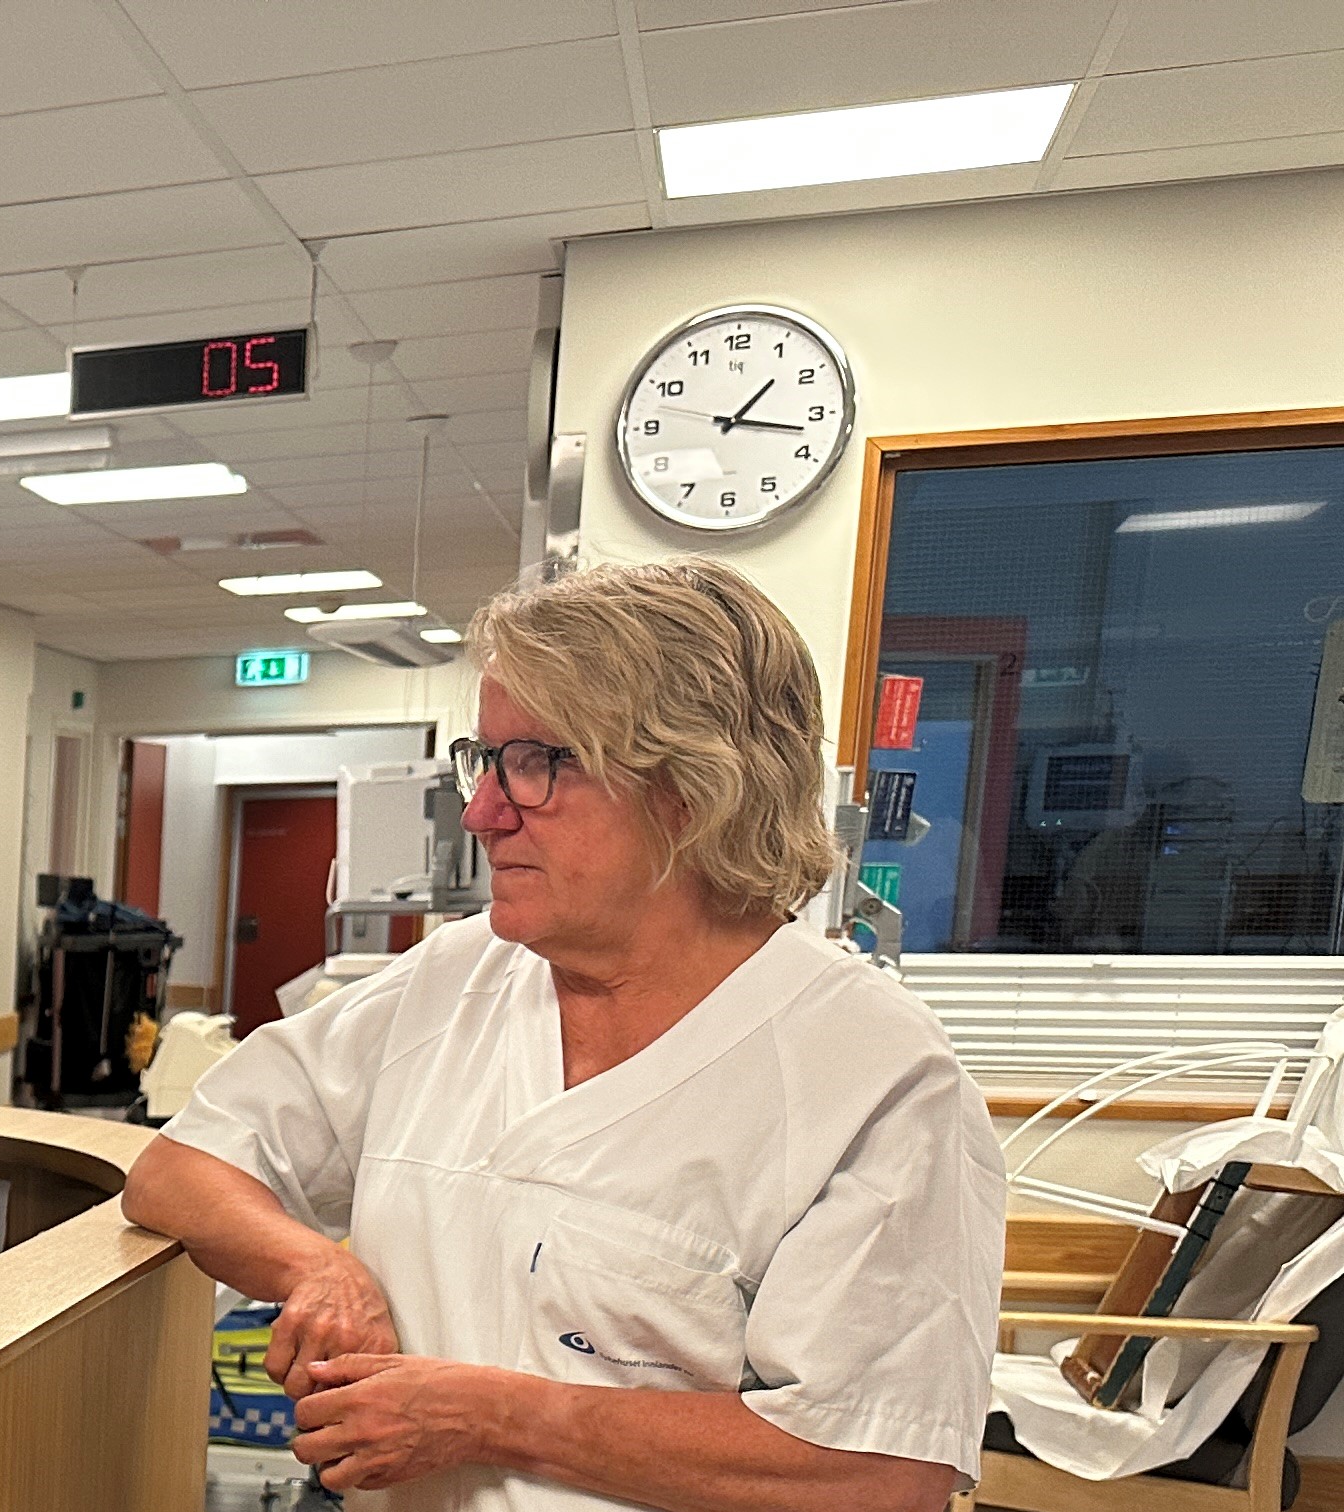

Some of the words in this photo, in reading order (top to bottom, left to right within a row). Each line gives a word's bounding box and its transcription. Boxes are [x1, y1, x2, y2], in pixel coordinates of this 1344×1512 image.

[724, 333, 751, 351] 12
[773, 342, 784, 358] 1
[202, 336, 280, 396] 05
[688, 349, 710, 366] 11
[798, 368, 815, 385] 2
[656, 380, 684, 397] 10
[808, 405, 825, 422] 3
[644, 420, 660, 436] 9
[794, 445, 811, 460] 4
[653, 456, 669, 472] 8
[680, 482, 696, 499] 7
[760, 476, 777, 492] 5
[720, 492, 736, 507] 6
